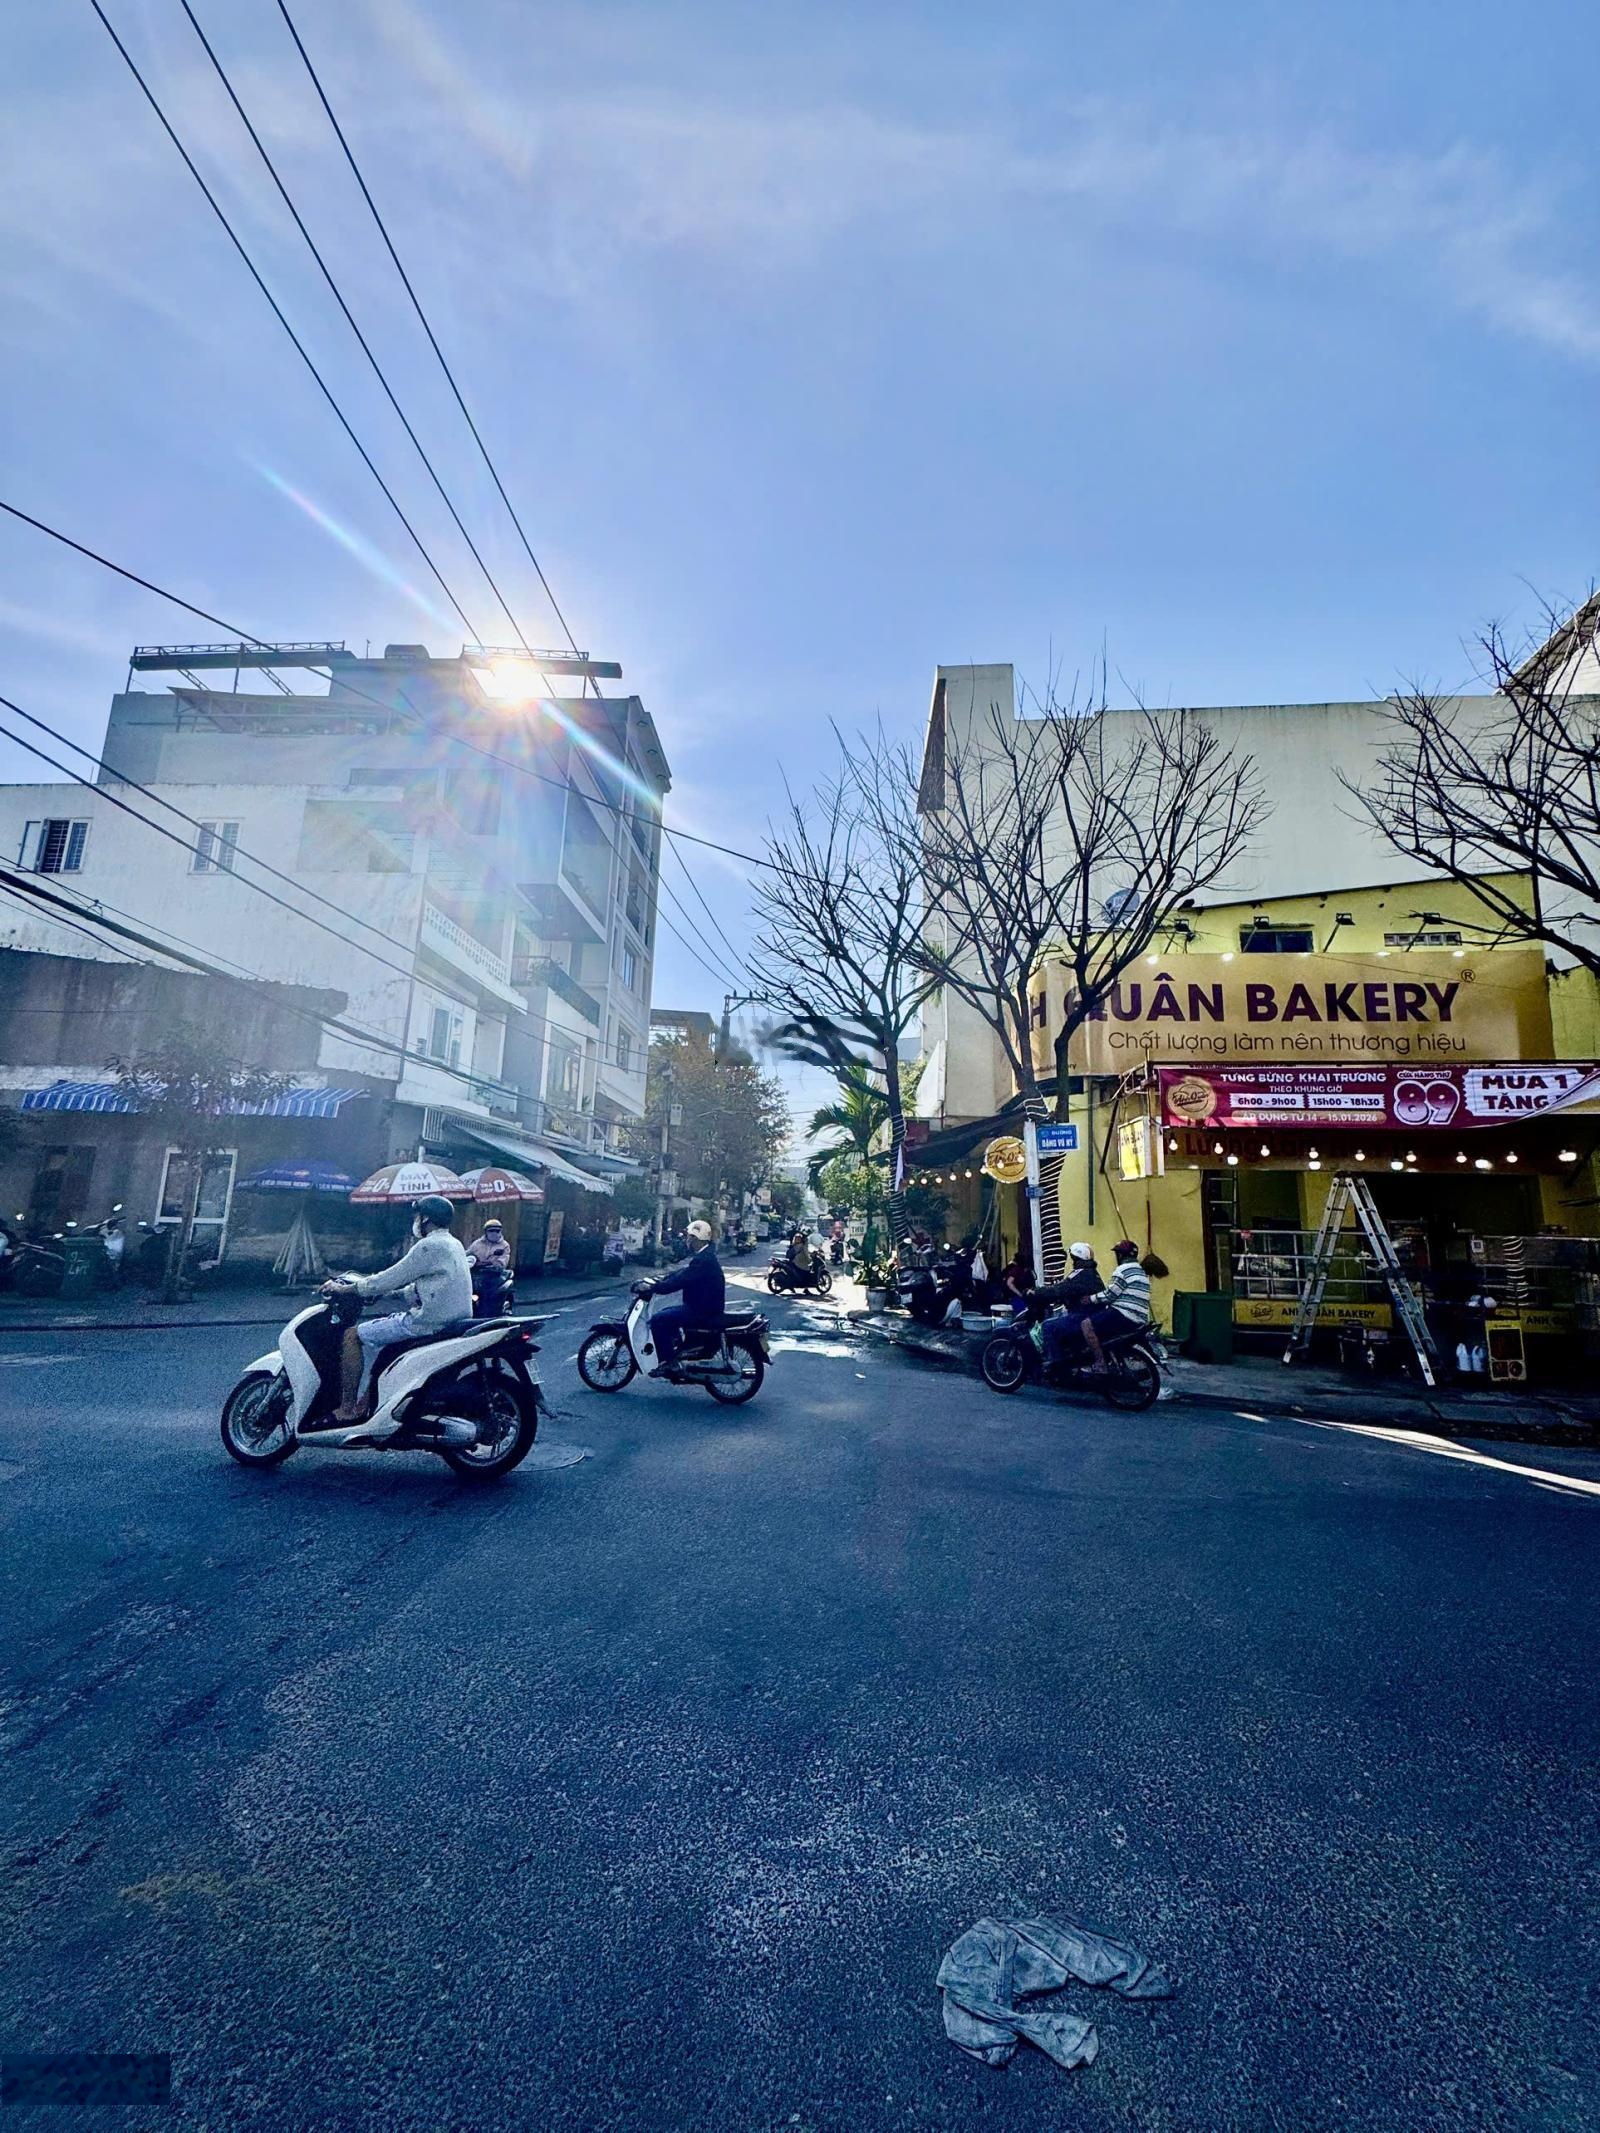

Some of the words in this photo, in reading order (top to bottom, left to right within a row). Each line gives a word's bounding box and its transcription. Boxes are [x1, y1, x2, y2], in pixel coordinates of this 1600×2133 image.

[1064, 972, 1224, 1022] QUÂN
[1245, 982, 1460, 1022] BAKERY
[1108, 1030, 1161, 1049] Chất
[1168, 1033, 1227, 1054] lượng
[1234, 1033, 1274, 1051] làm
[1281, 1033, 1323, 1051] nên
[1329, 1033, 1410, 1055] thương
[1417, 1033, 1466, 1054] hiệu
[1258, 1071, 1294, 1082] BỪNG
[1299, 1073, 1331, 1082] KHAI
[1333, 1072, 1387, 1082] TRƯƠNG
[1481, 1075, 1549, 1090] MUA
[1555, 1075, 1568, 1089] 1
[1269, 1085, 1292, 1093] THEO
[1294, 1085, 1325, 1093] KHUNG
[1327, 1084, 1343, 1093] GIỜ
[1238, 1097, 1263, 1105] 6h00
[1271, 1097, 1297, 1105] 9h00
[1312, 1097, 1341, 1106] 15h00
[1351, 1097, 1380, 1106] 18h30
[1394, 1080, 1460, 1125] 89
[1483, 1093, 1550, 1112] TẶNG
[1258, 1113, 1288, 1123] DỤNG
[1306, 1113, 1317, 1121] 14
[1328, 1113, 1377, 1122] 15.01.2026
[1338, 1309, 1376, 1318] BAKERY
